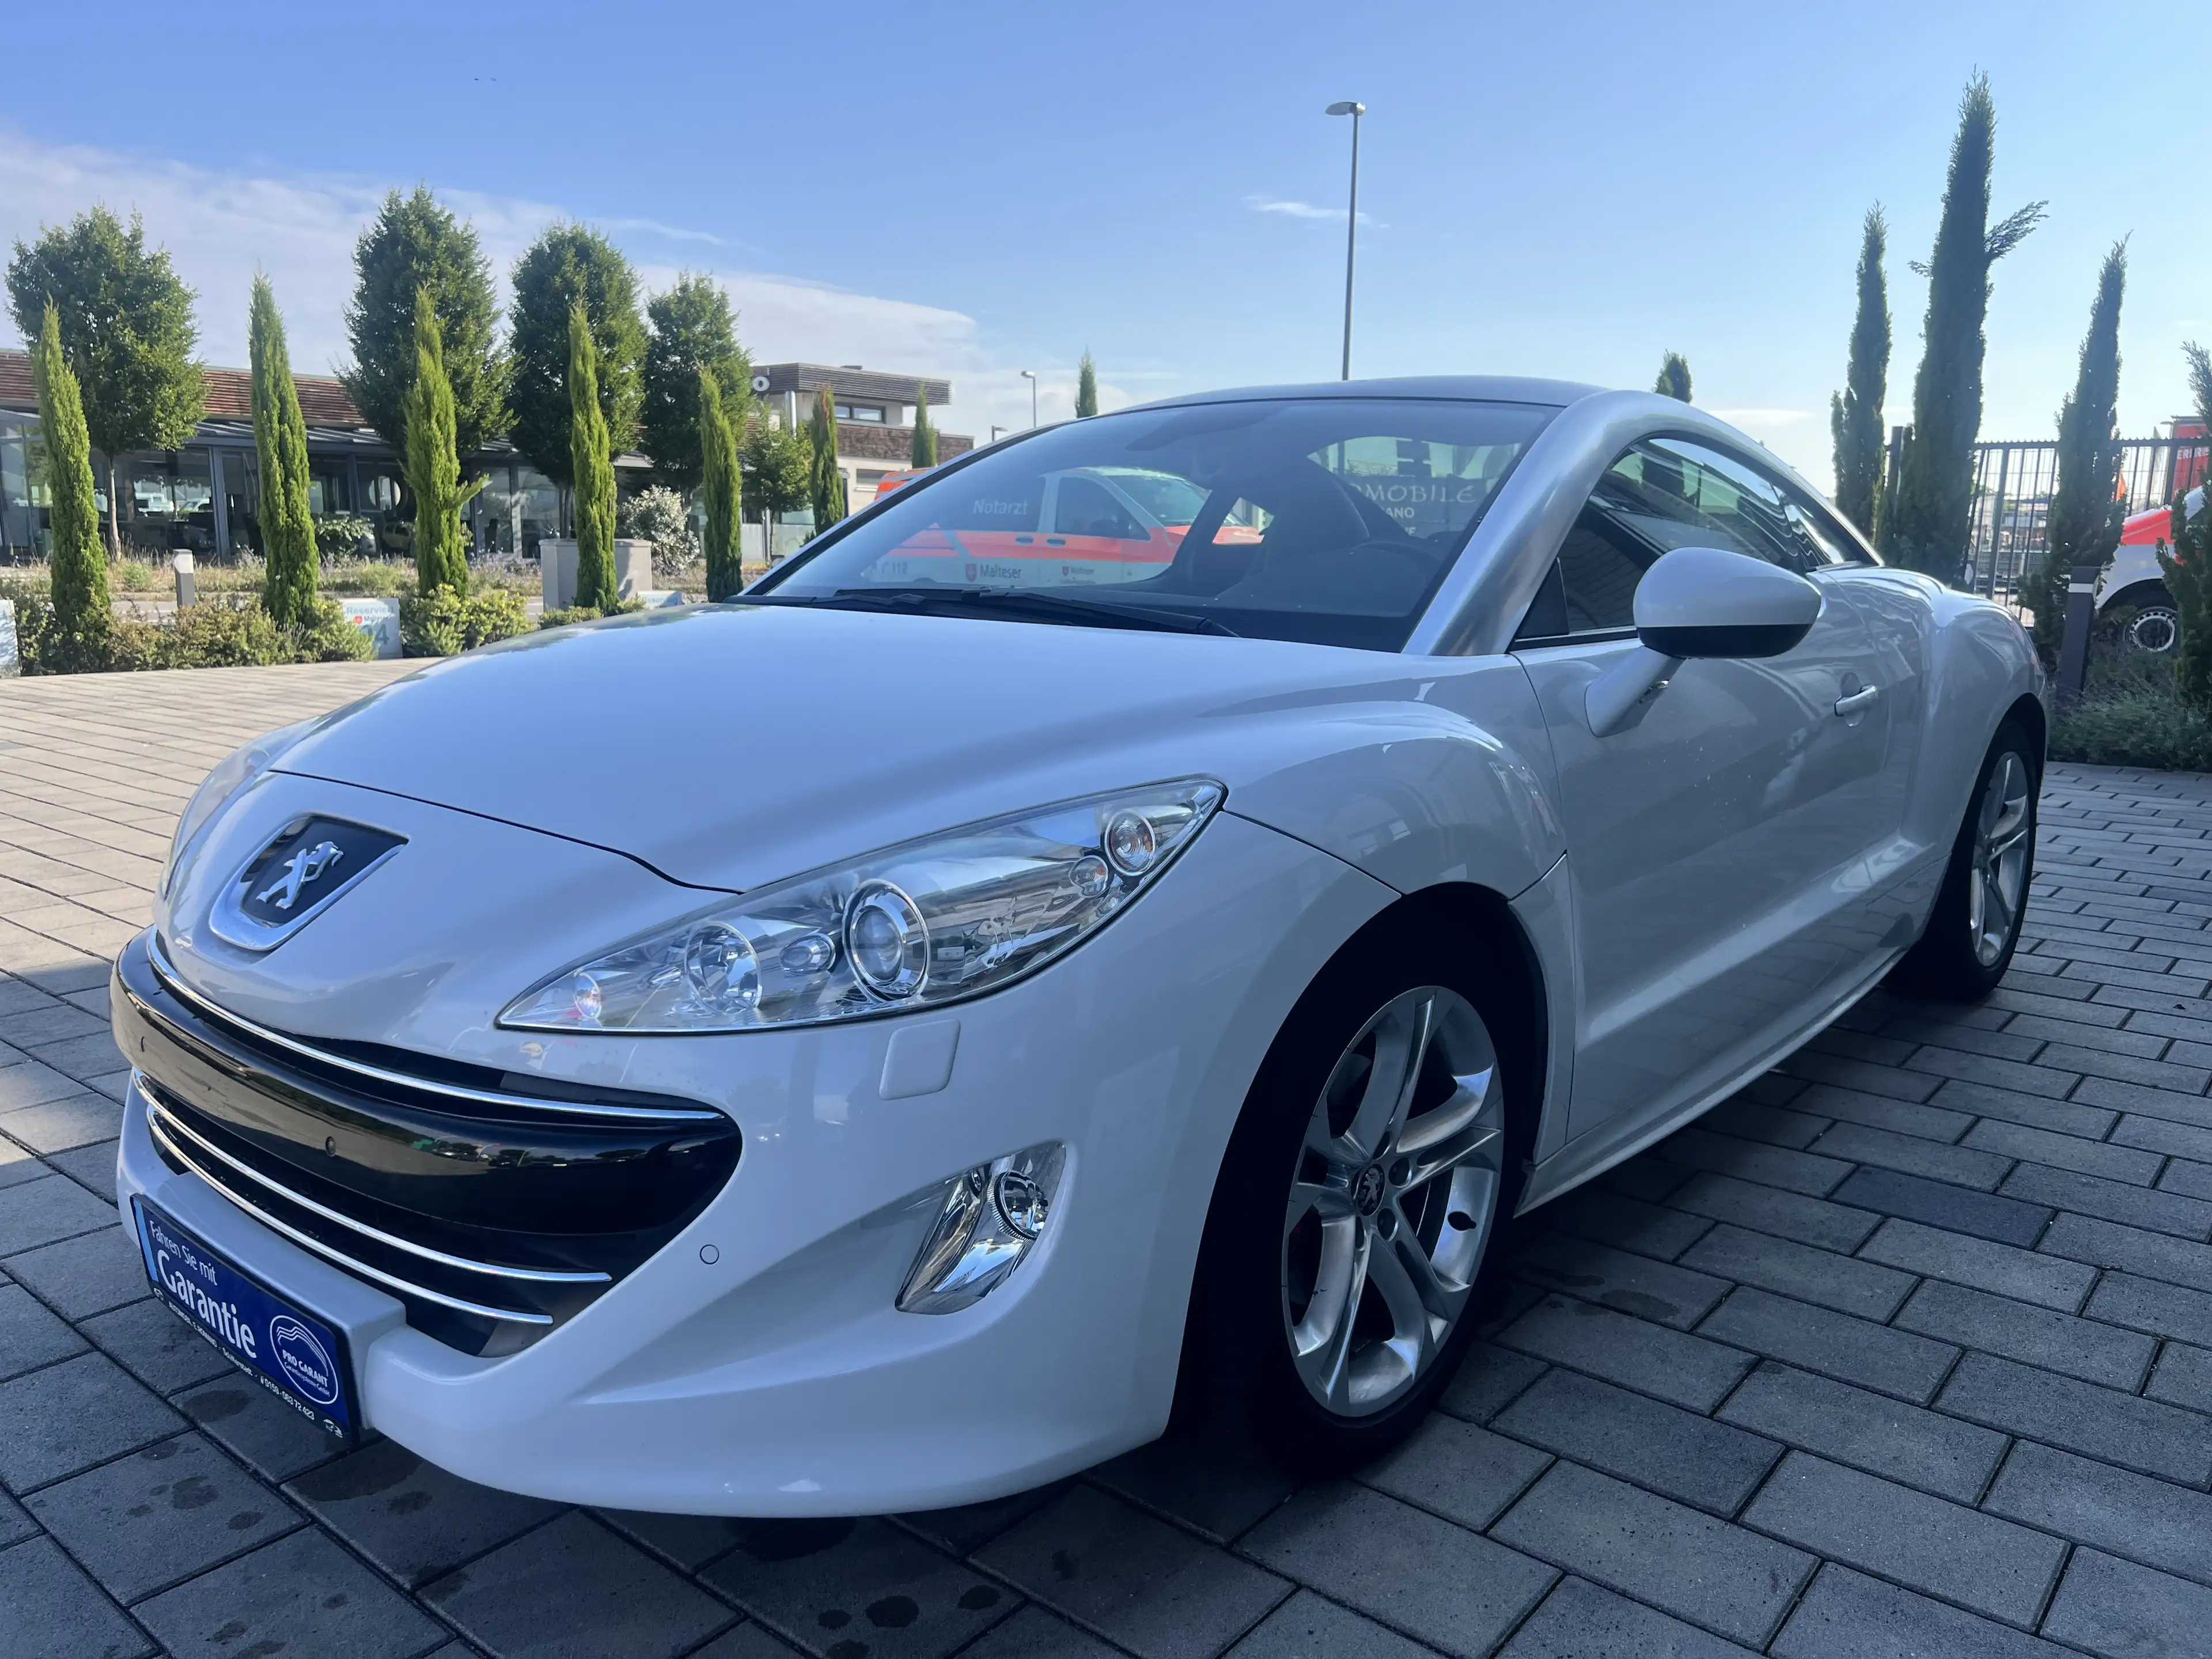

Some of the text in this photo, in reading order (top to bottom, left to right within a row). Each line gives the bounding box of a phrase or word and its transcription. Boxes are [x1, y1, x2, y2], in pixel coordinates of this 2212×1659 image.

[972, 499, 1028, 515] Notarzt
[1381, 507, 1415, 518] ANO
[980, 564, 1022, 578] Malteser
[150, 1220, 218, 1286] Fahren Sie mit
[157, 1249, 257, 1358] Garantie
[282, 1349, 328, 1387] PRO GARANT
[294, 1399, 302, 1412] 72
[302, 1407, 315, 1421] 423
